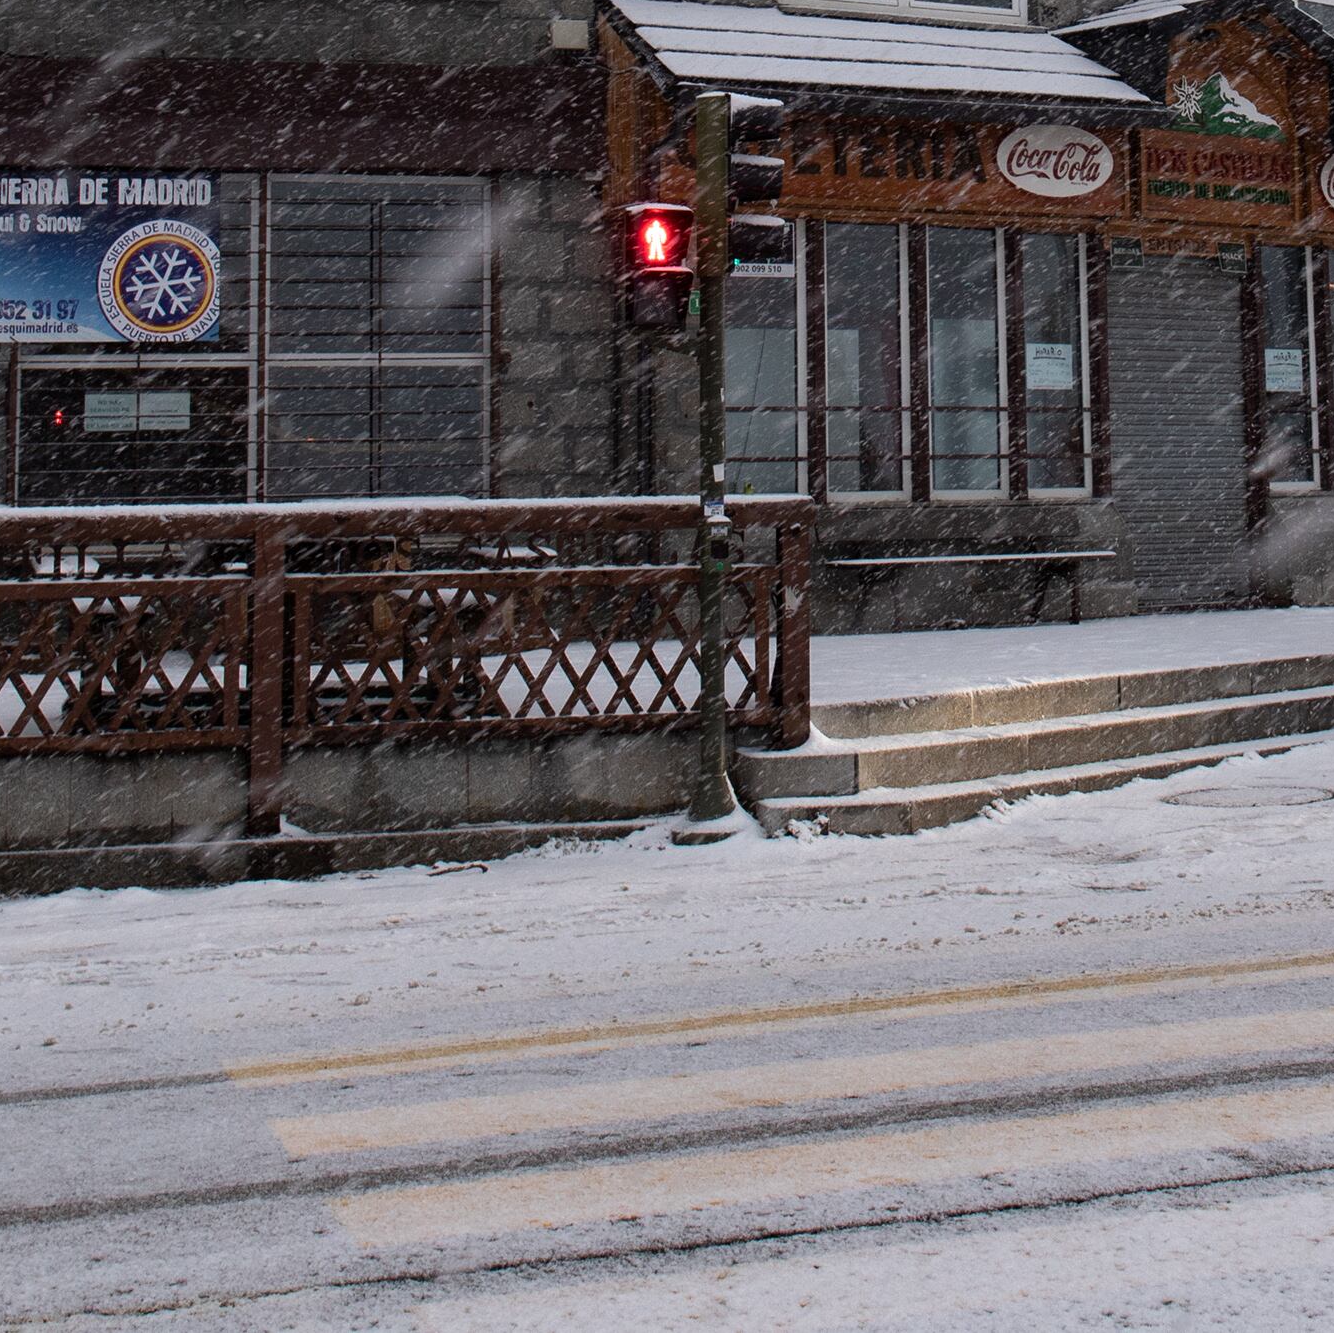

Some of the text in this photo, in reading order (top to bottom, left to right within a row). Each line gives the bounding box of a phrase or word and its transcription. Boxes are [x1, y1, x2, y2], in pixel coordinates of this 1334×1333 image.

[1006, 138, 1104, 182] Coca-Cola
[79, 178, 109, 206] DE
[118, 178, 212, 206] MADRID
[19, 214, 31, 233] &
[36, 214, 82, 233] Snow
[101, 222, 210, 320] ESCUELA SIERRA DE MADRID
[32, 300, 52, 320] 31
[56, 300, 80, 320] 97
[122, 322, 171, 342] PUERTO
[173, 331, 190, 342] DE
